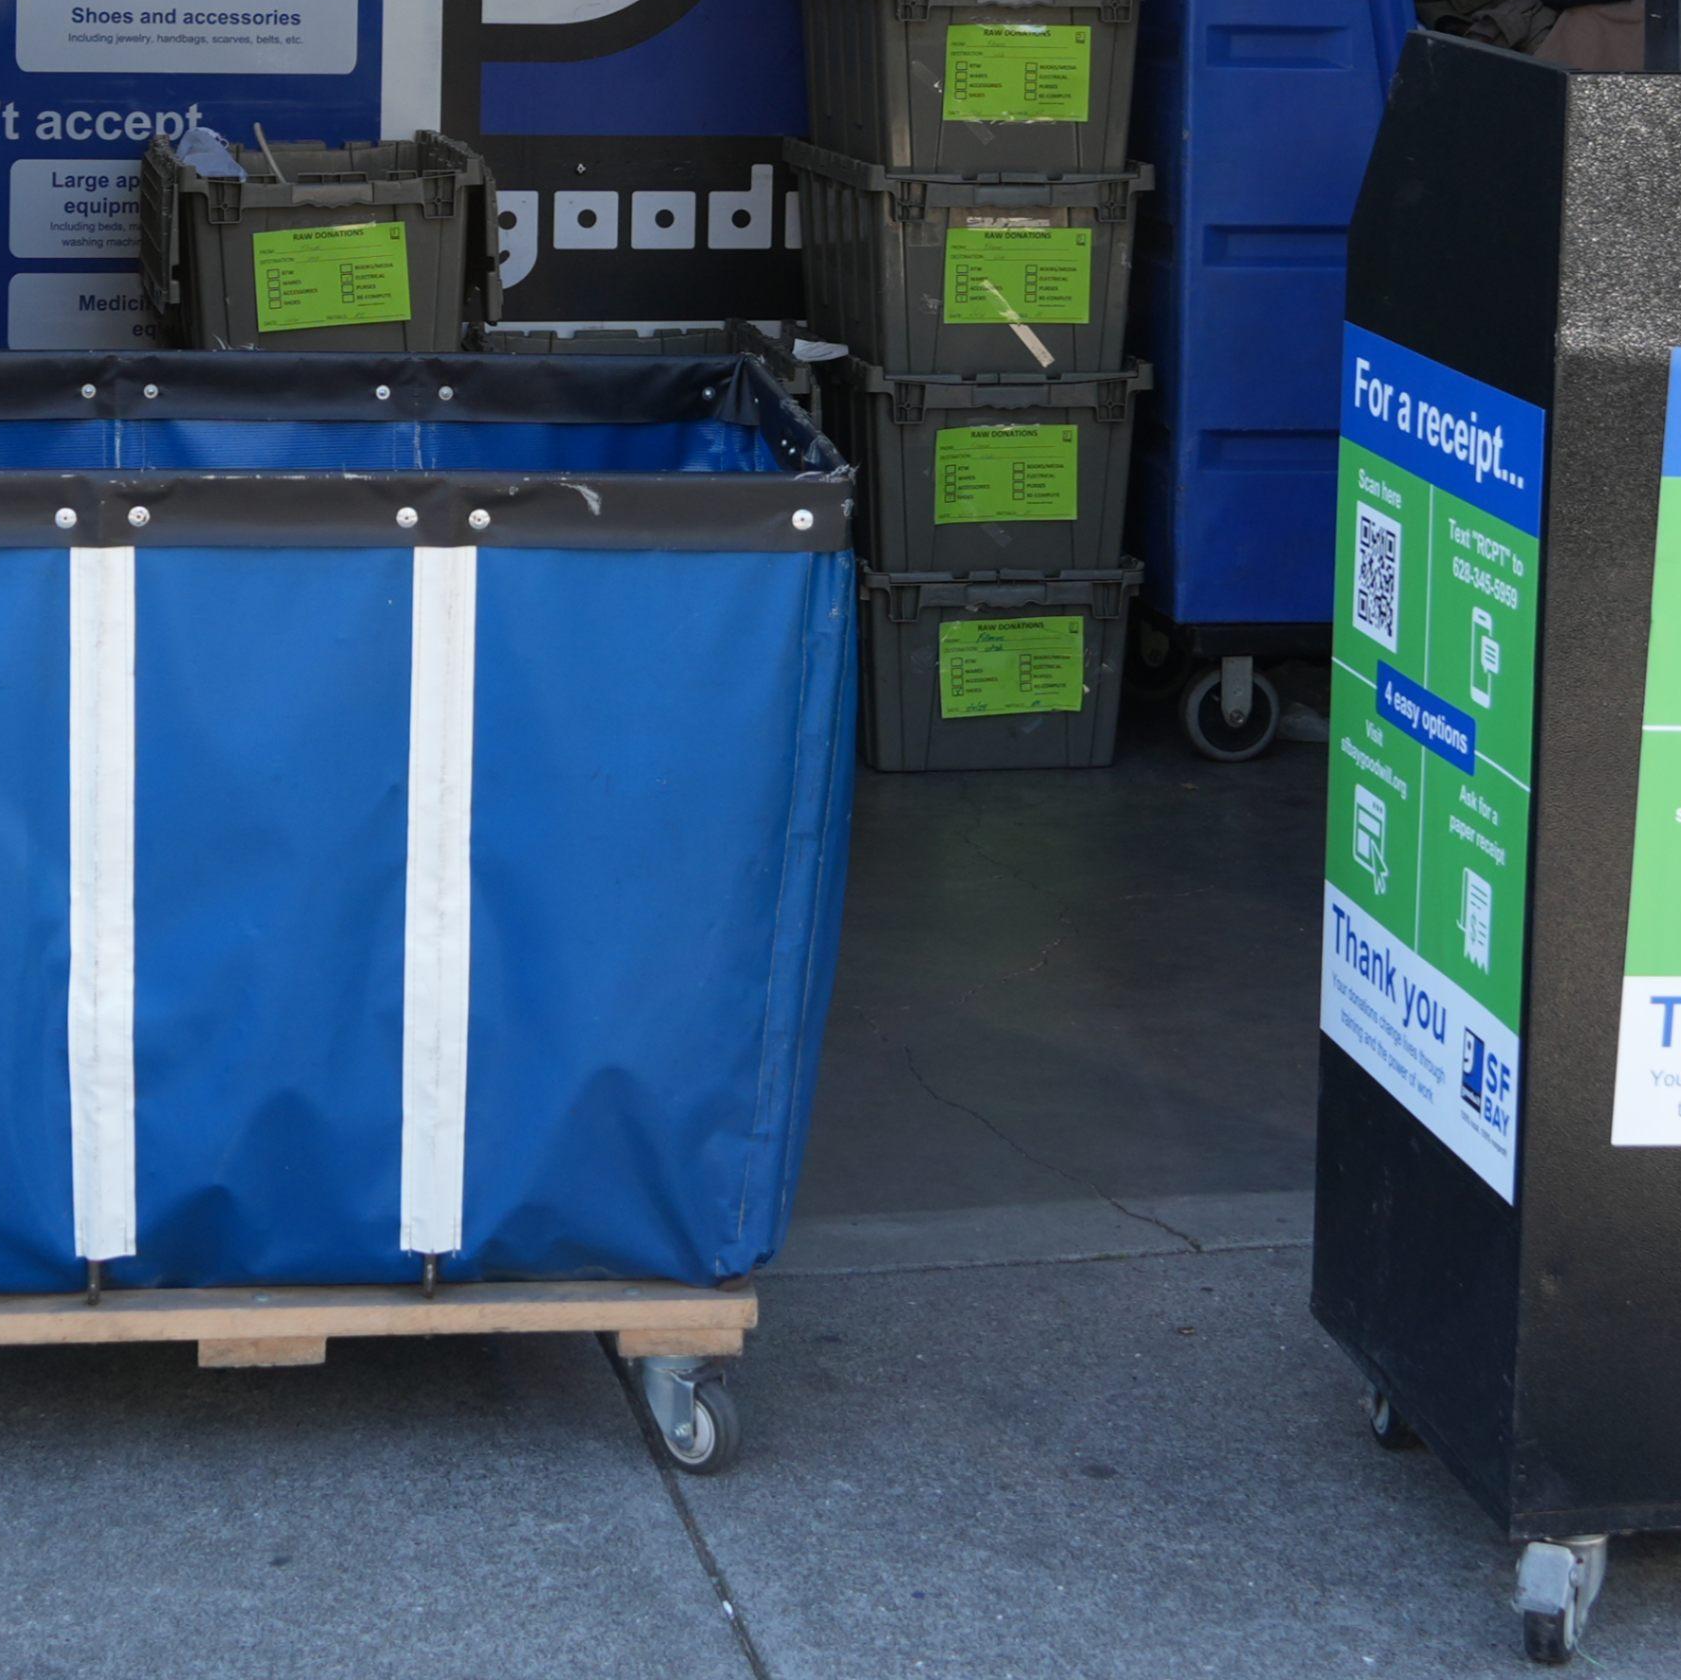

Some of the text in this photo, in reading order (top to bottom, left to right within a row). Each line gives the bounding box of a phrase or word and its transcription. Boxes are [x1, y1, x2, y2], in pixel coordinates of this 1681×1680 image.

[71, 7, 301, 26] Shoes and accessories
[68, 32, 113, 45] Including
[115, 33, 154, 45] jewelry,
[156, 33, 208, 45] handbags,
[35, 102, 202, 142] accept
[51, 170, 110, 194] Large
[64, 196, 140, 219] equipm
[293, 229, 364, 241] RAW DONATIONS
[971, 429, 1038, 438] RAW DONATIONS
[1354, 357, 1525, 490] For a receipt...
[1384, 681, 1469, 755] 4 easy options
[1332, 903, 1447, 1045] Thank you
[1485, 1052, 1510, 1102] SF
[1483, 1095, 1509, 1138] BAY
